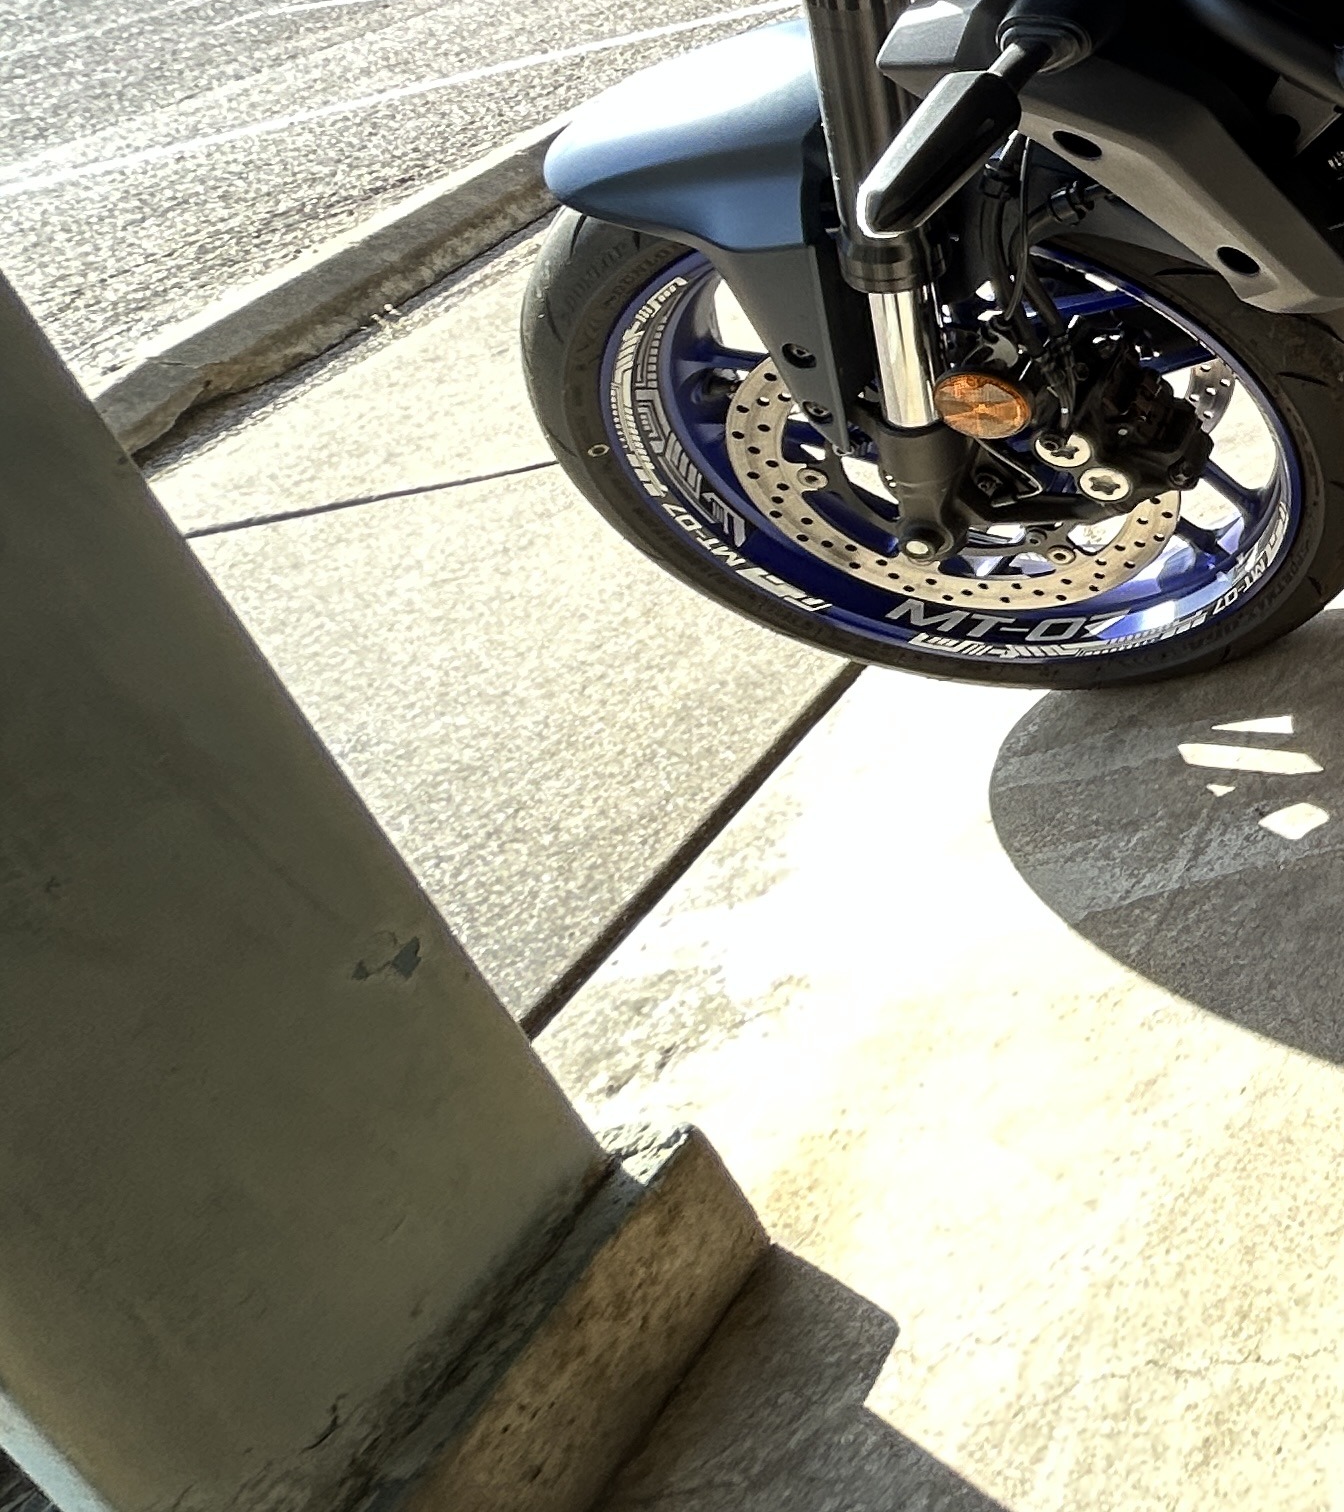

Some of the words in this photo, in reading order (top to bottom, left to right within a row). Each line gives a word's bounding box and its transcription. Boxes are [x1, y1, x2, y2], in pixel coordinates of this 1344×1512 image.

[661, 502, 747, 568] MT-07
[1212, 550, 1268, 616] MT-07
[885, 599, 1130, 643] MT-07
